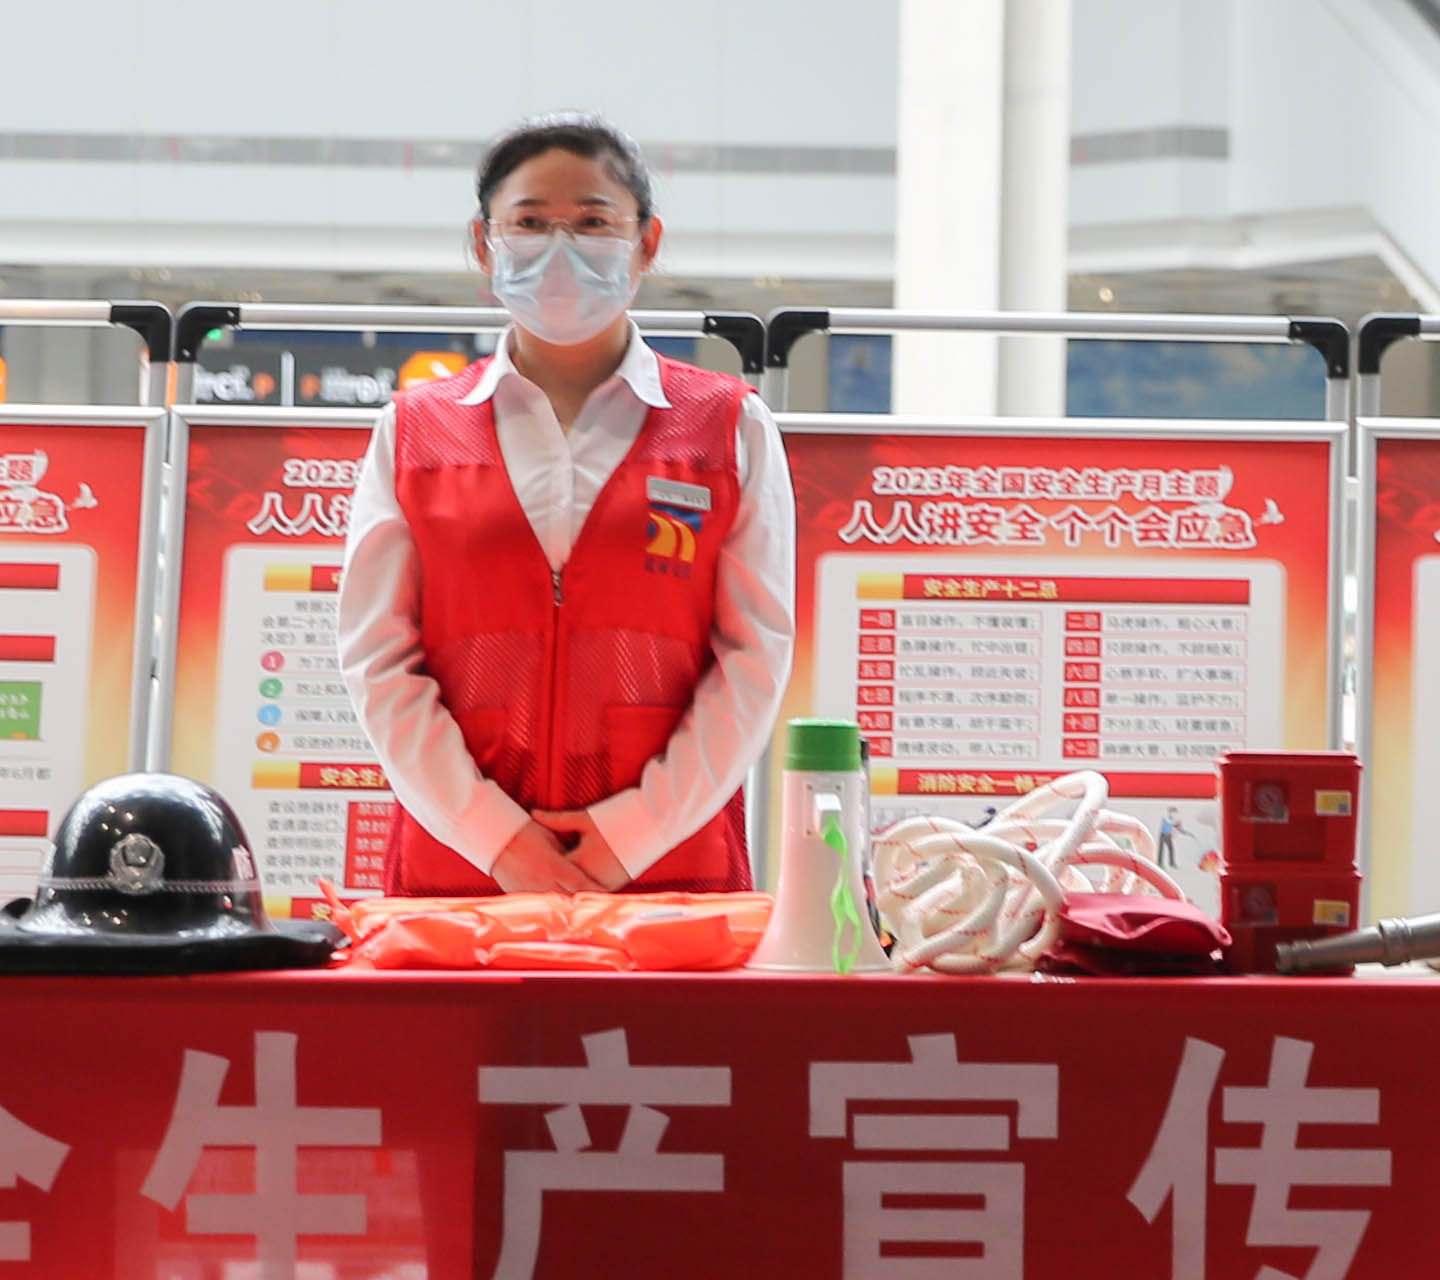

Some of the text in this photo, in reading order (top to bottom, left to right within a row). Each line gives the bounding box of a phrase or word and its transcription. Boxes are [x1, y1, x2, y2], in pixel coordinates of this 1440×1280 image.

[871, 465, 1223, 501] 2023年全国安全生产月主题
[839, 504, 1257, 549] 人人讲安全 个个会应急
